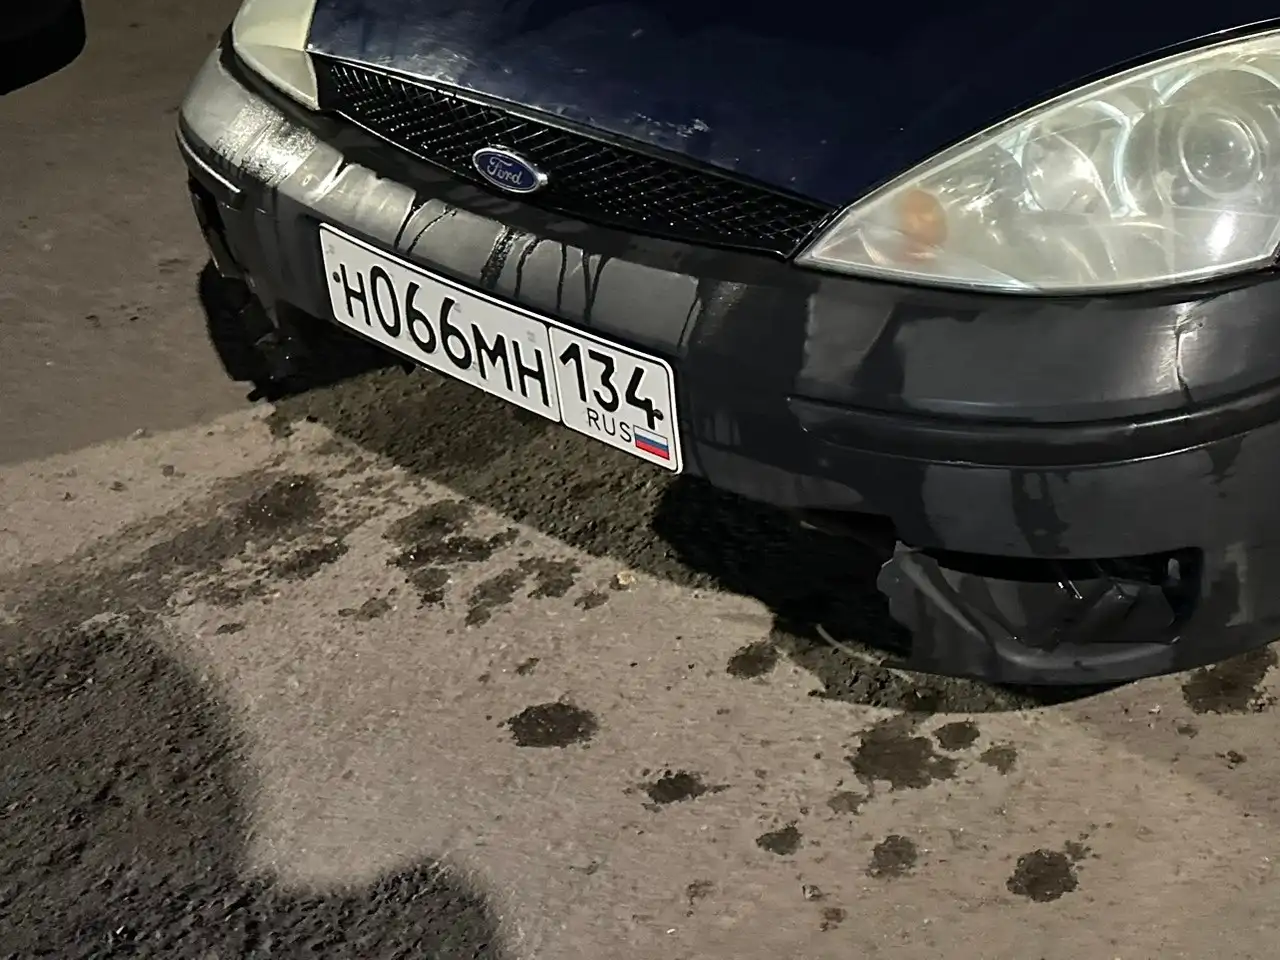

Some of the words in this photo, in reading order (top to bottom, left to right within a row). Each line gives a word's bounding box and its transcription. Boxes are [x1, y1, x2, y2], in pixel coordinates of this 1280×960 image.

[486, 155, 524, 185] Ford
[560, 343, 662, 429] 134
[587, 408, 632, 443] RUS
